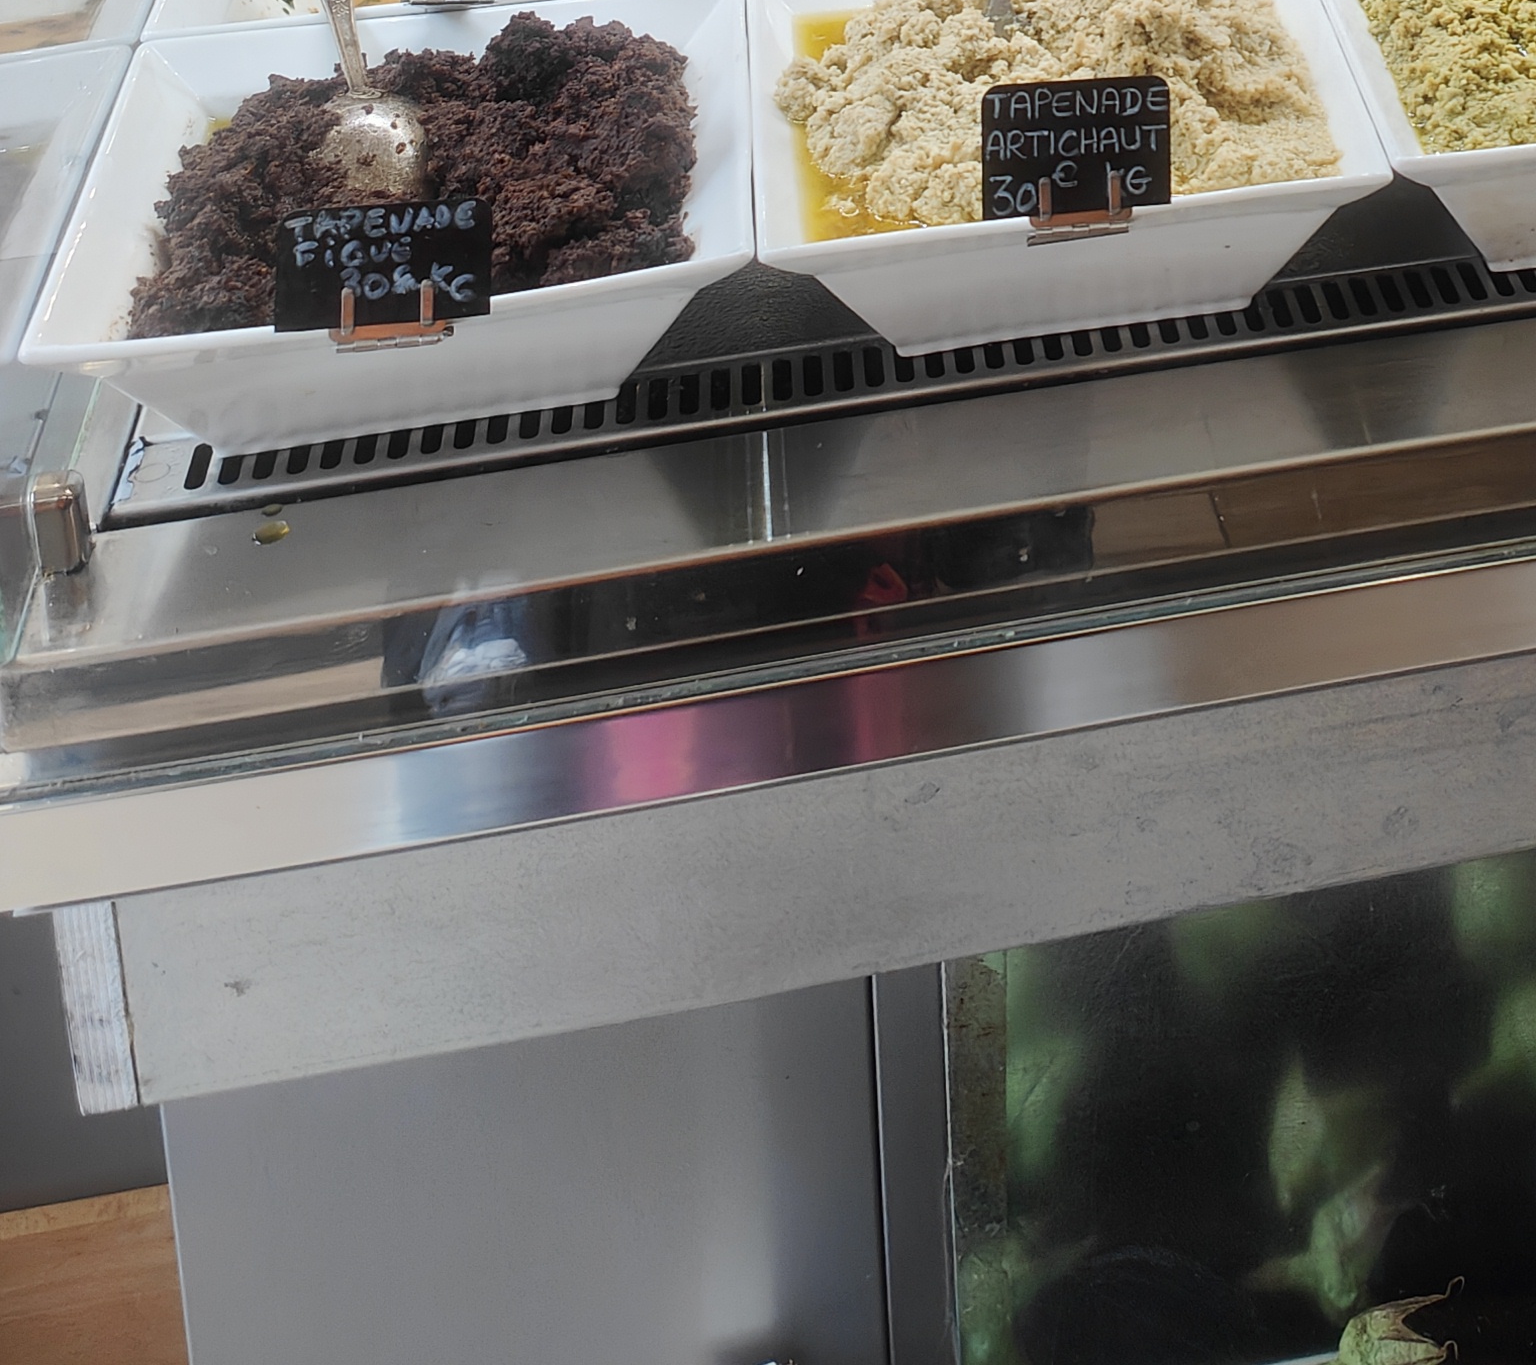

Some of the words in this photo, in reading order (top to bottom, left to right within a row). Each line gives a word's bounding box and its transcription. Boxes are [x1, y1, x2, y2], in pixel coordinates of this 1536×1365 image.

[985, 87, 1168, 120] TAPENADE
[985, 124, 1168, 161] ARTICHAUT
[989, 175, 1037, 216] 30
[1052, 160, 1078, 188] €
[284, 200, 477, 243] TAPENADE
